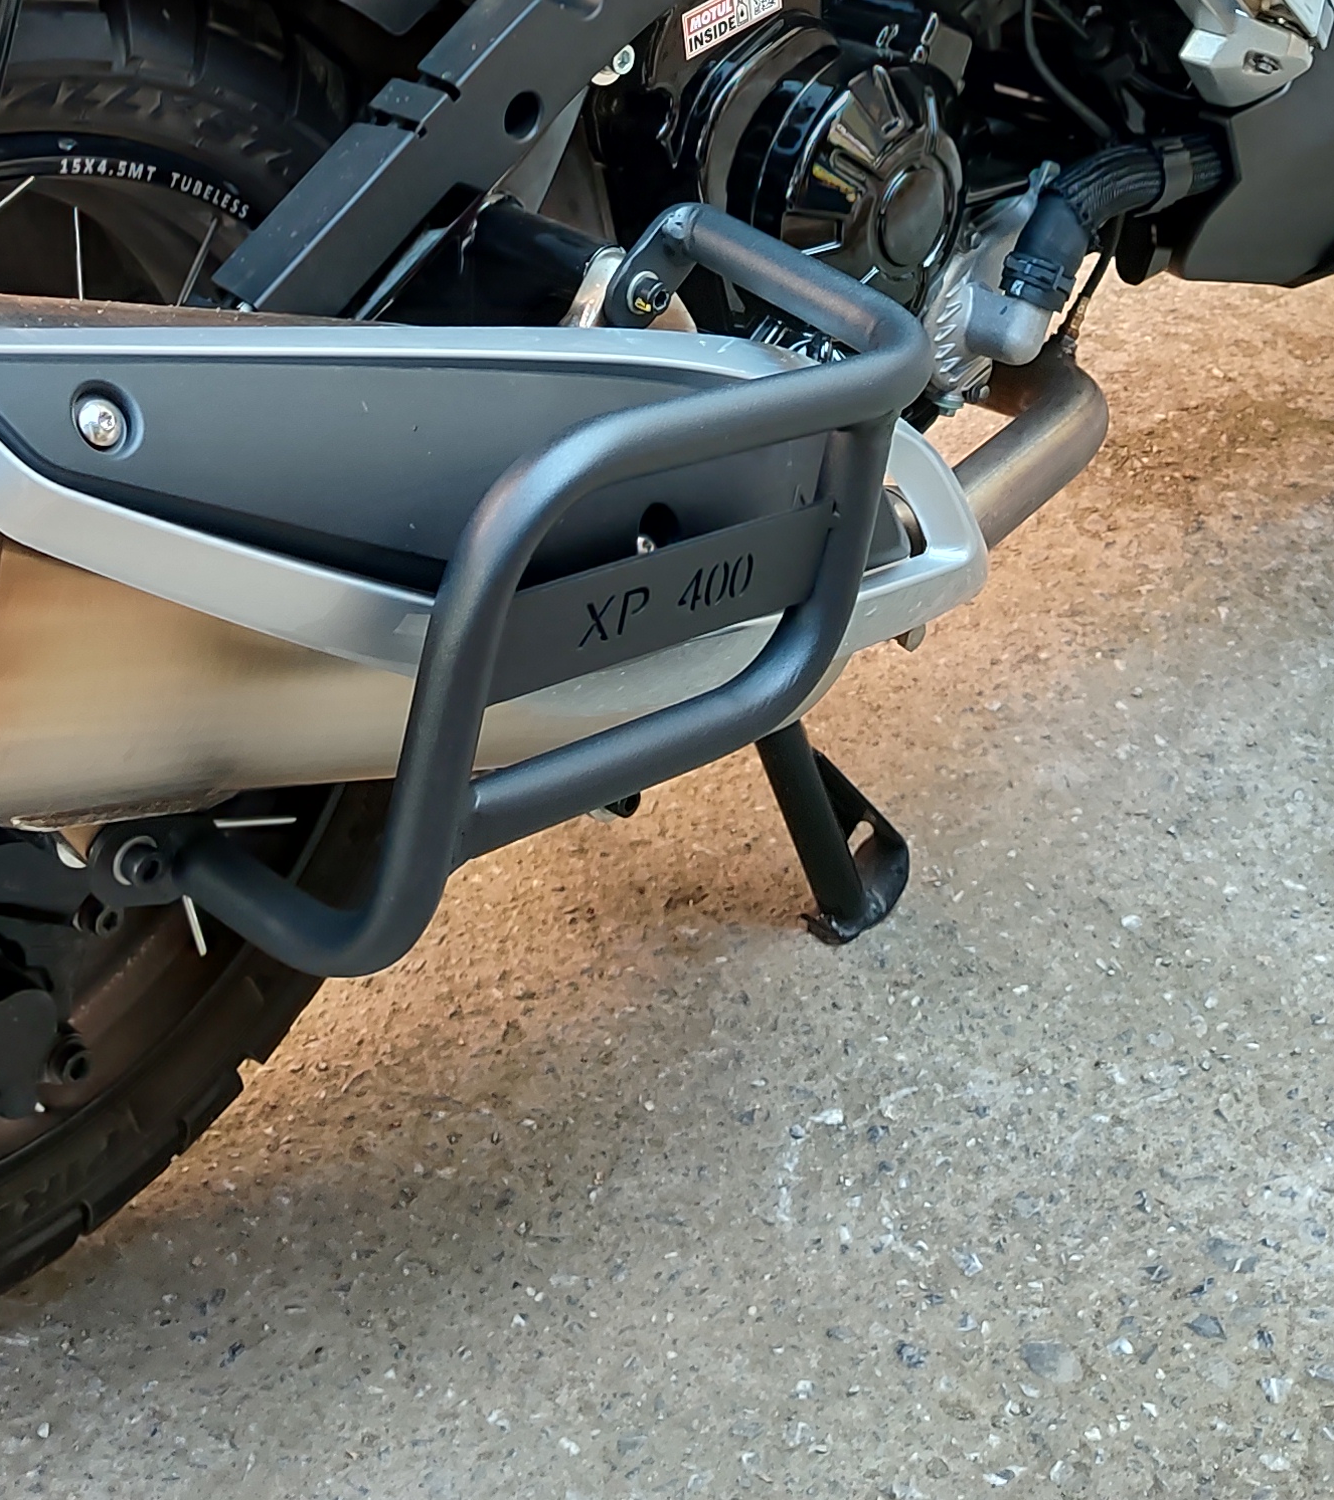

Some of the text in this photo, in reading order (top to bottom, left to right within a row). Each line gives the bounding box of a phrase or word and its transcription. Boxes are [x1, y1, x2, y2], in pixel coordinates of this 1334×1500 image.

[688, 14, 737, 53] INSIDE
[58, 157, 250, 220] 15X4.5MT TUBELESS
[577, 552, 754, 649] XP 400
